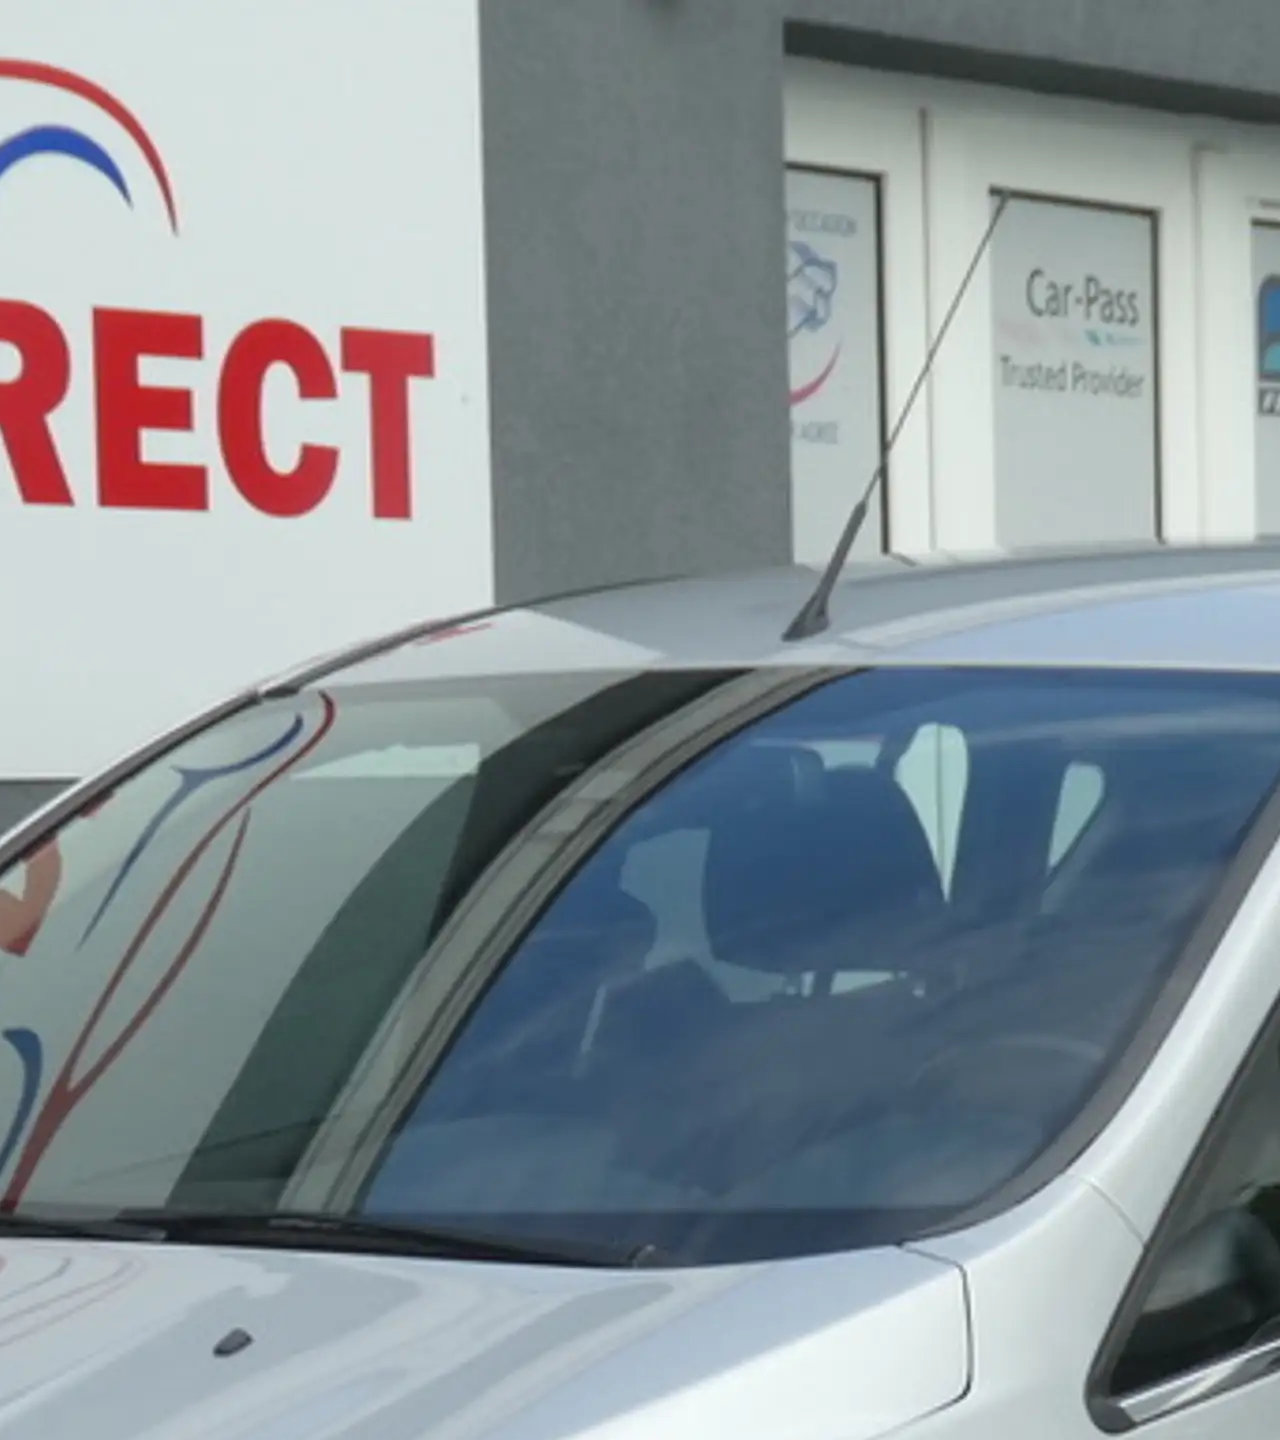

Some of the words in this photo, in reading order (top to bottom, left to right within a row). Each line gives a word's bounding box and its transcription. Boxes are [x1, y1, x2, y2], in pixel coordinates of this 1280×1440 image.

[1025, 266, 1140, 328] Car-Pass
[1000, 354, 1067, 391] Trusted
[1071, 360, 1145, 398] Provider
